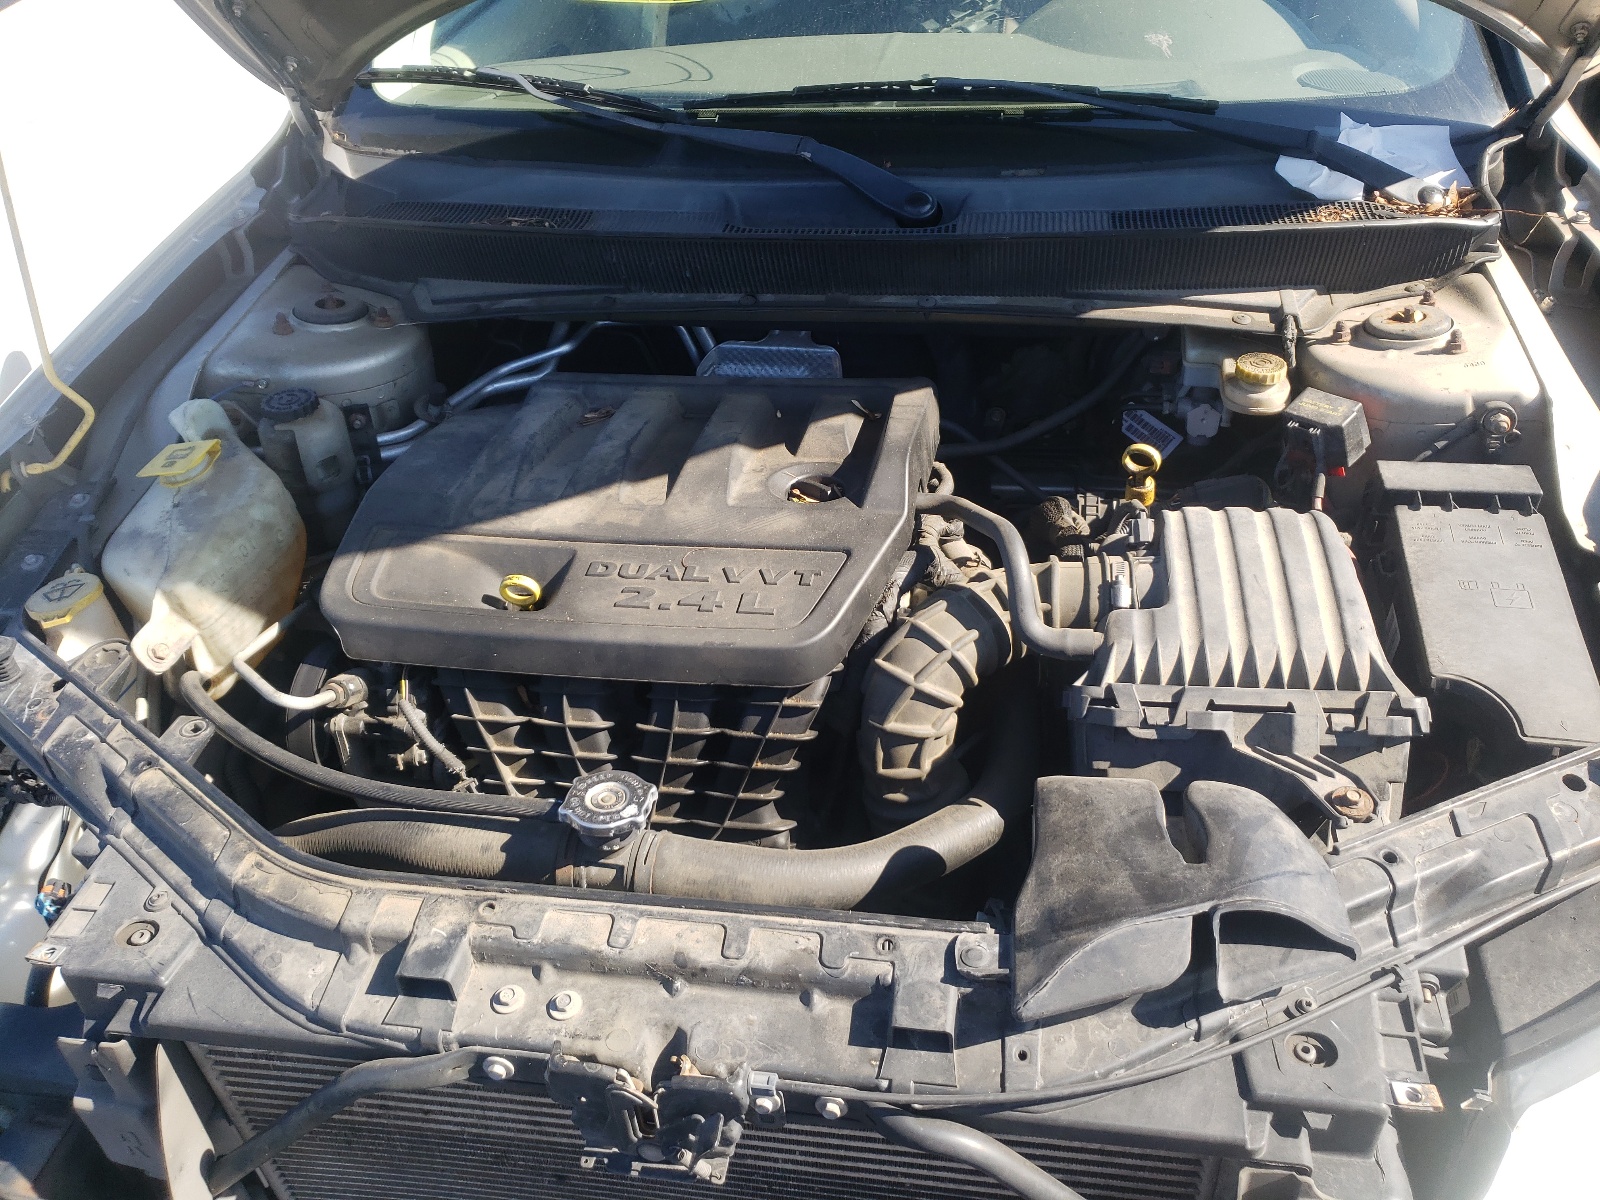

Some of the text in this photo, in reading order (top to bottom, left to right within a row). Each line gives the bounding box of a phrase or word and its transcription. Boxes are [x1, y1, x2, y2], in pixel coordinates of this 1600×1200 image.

[585, 561, 822, 587] DUAL VVT
[613, 586, 775, 615] 2.4L
